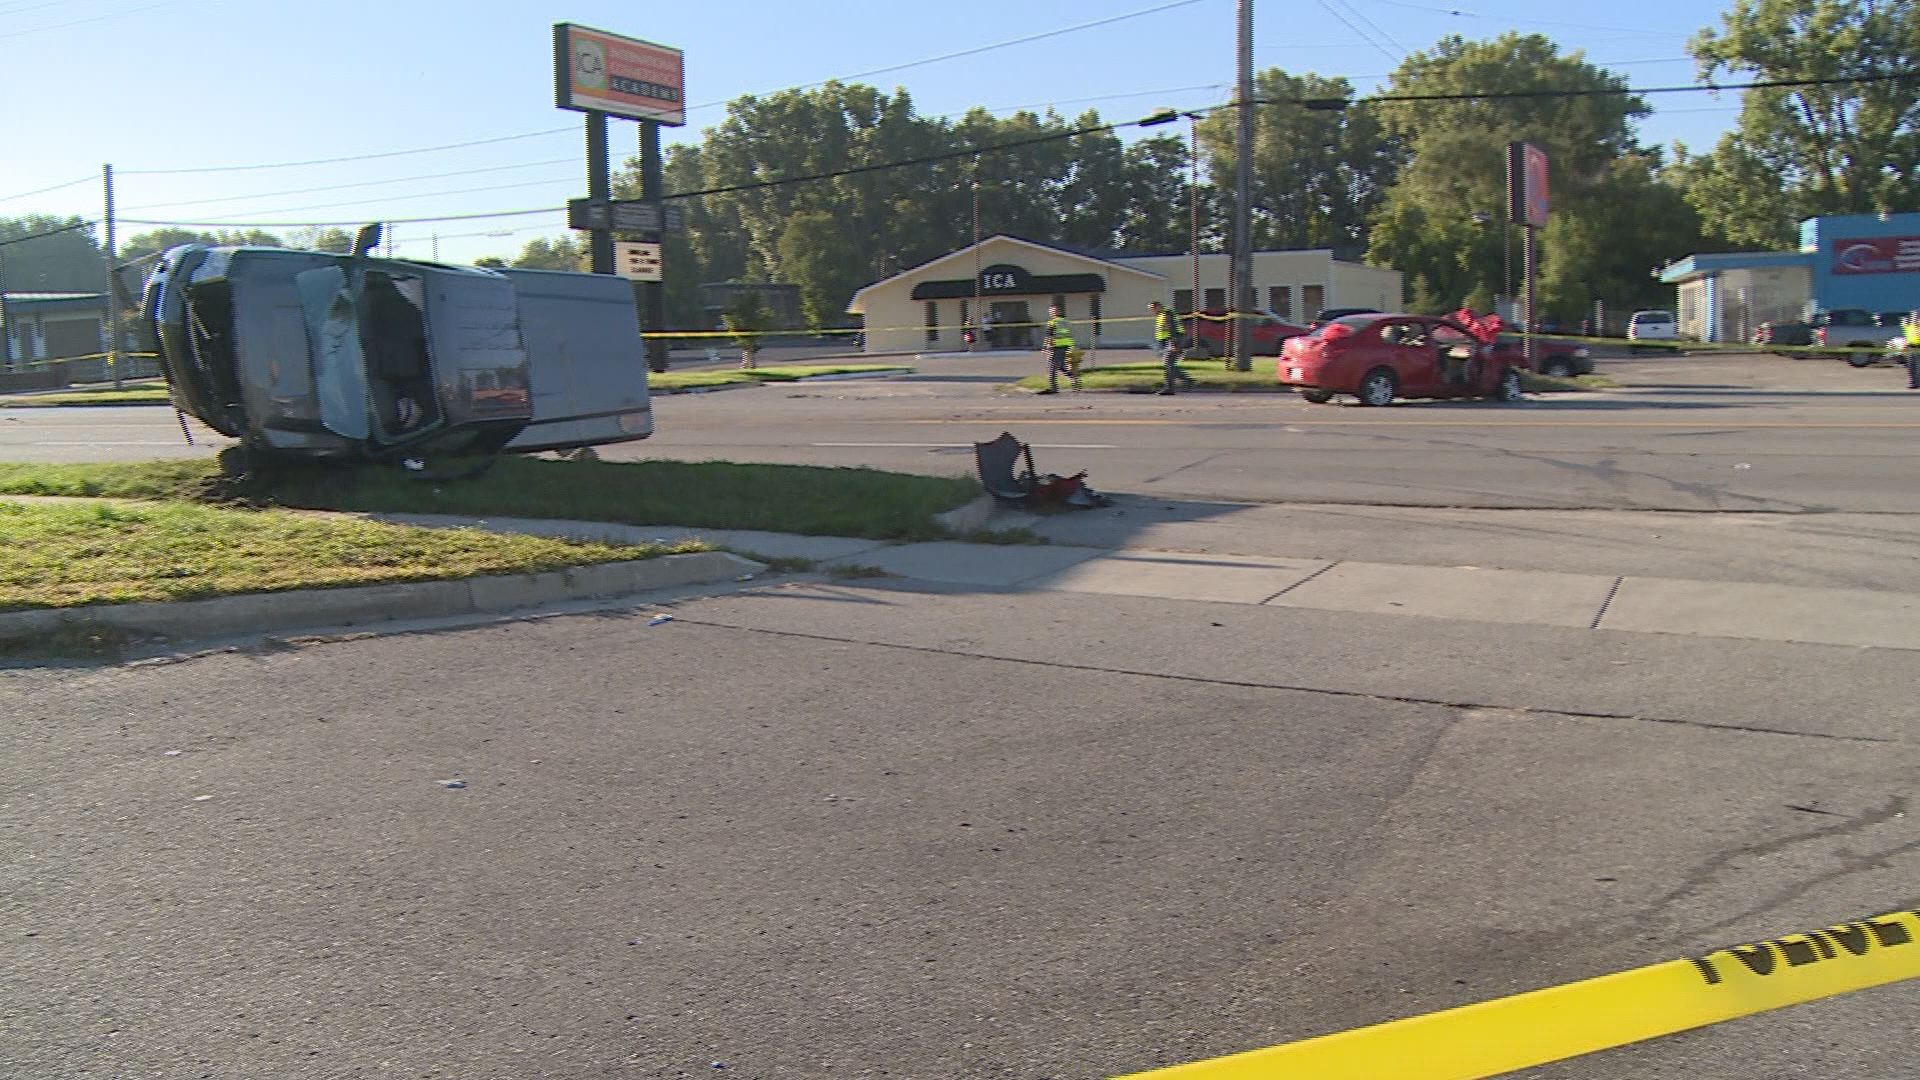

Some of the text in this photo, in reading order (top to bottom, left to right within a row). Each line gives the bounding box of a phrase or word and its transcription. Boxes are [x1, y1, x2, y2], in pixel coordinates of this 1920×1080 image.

[575, 51, 603, 75] ICA
[611, 78, 678, 101] ACADEMY
[984, 273, 1016, 289] ICA
